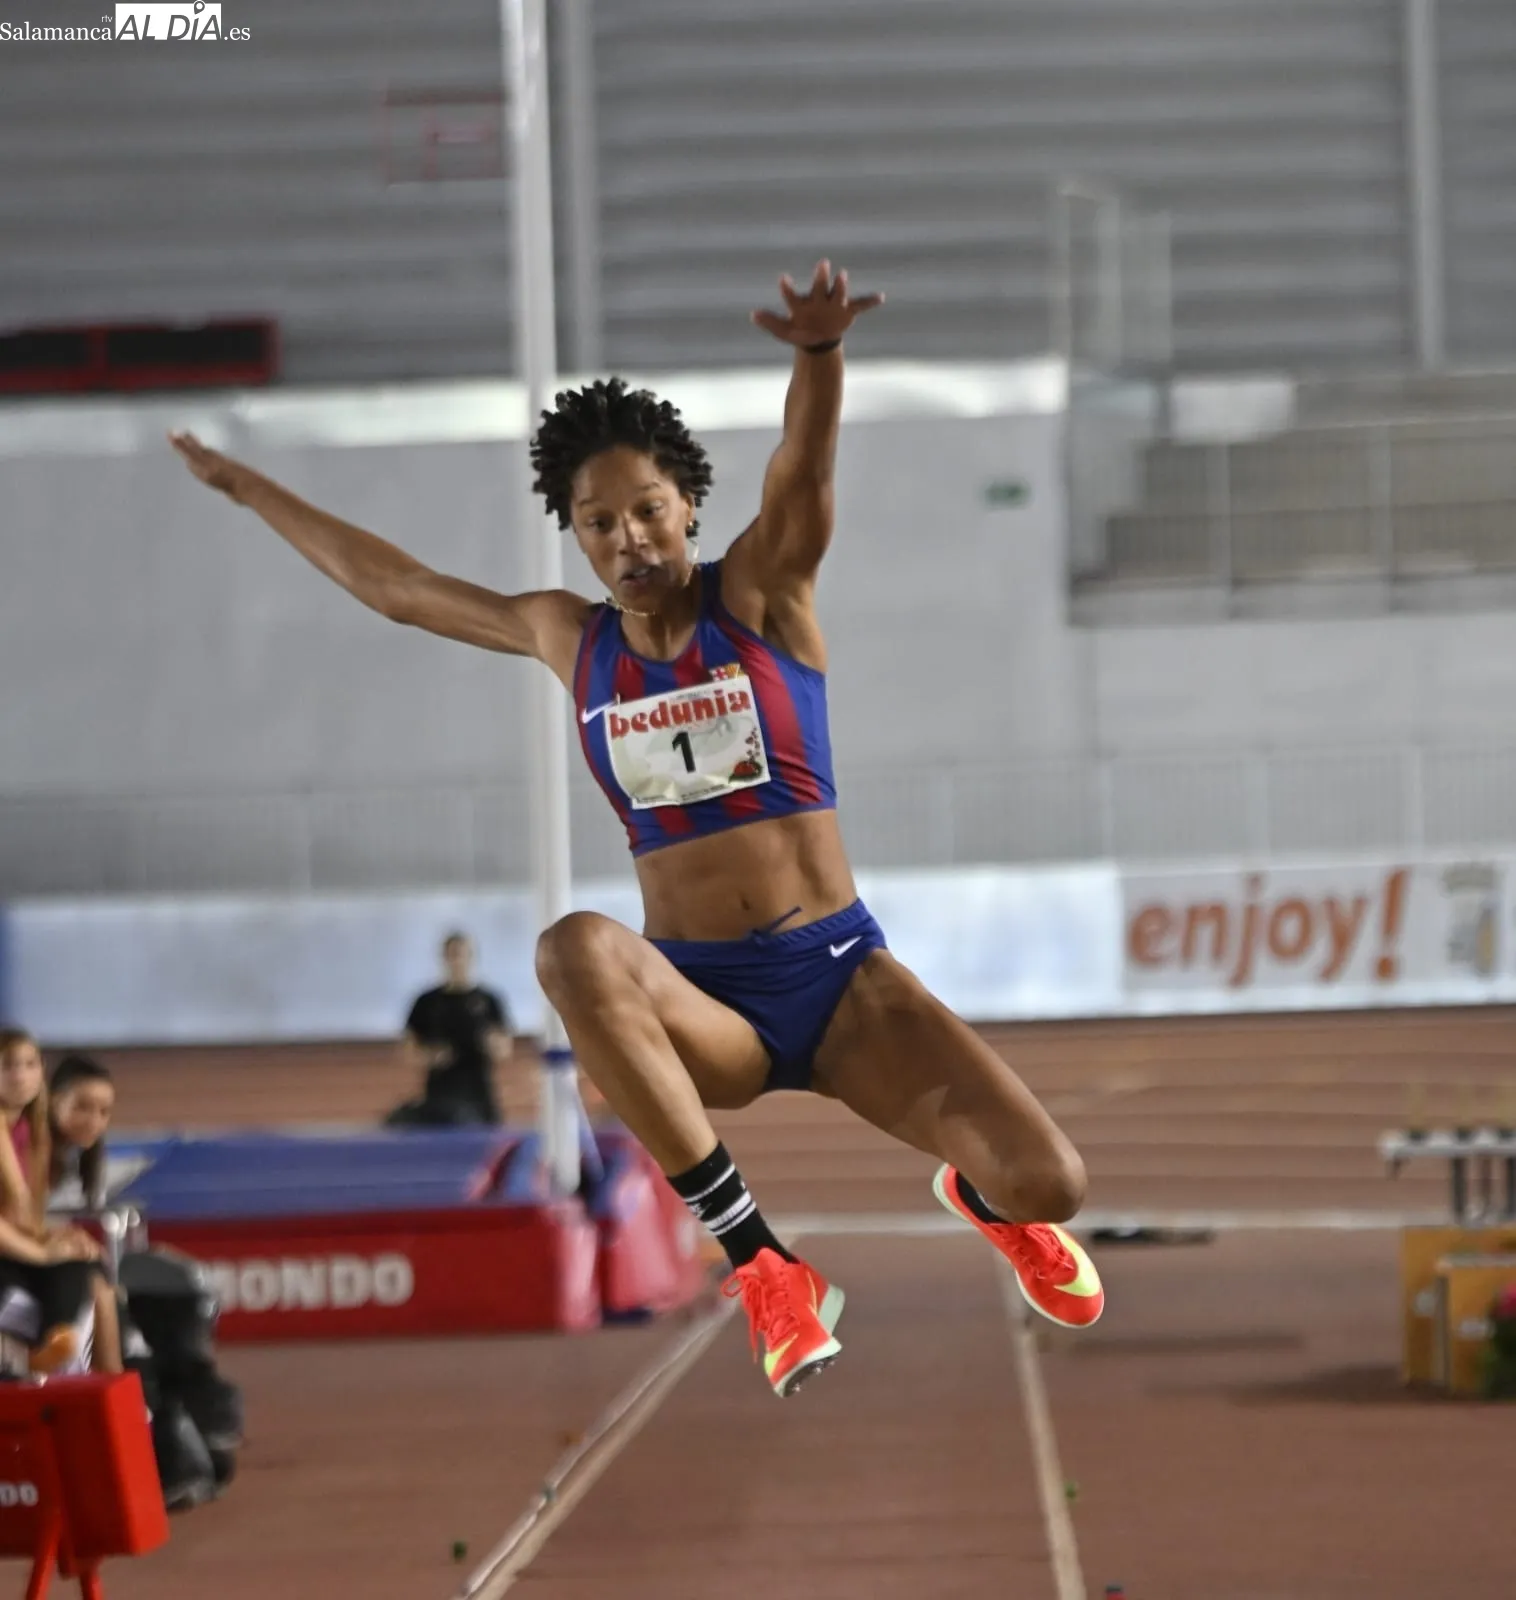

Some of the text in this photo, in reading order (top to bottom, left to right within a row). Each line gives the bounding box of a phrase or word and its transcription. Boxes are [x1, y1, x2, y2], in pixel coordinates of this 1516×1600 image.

[609, 689, 752, 740] bedunia
[671, 731, 697, 774] 1
[1127, 867, 1411, 988] enjoy!
